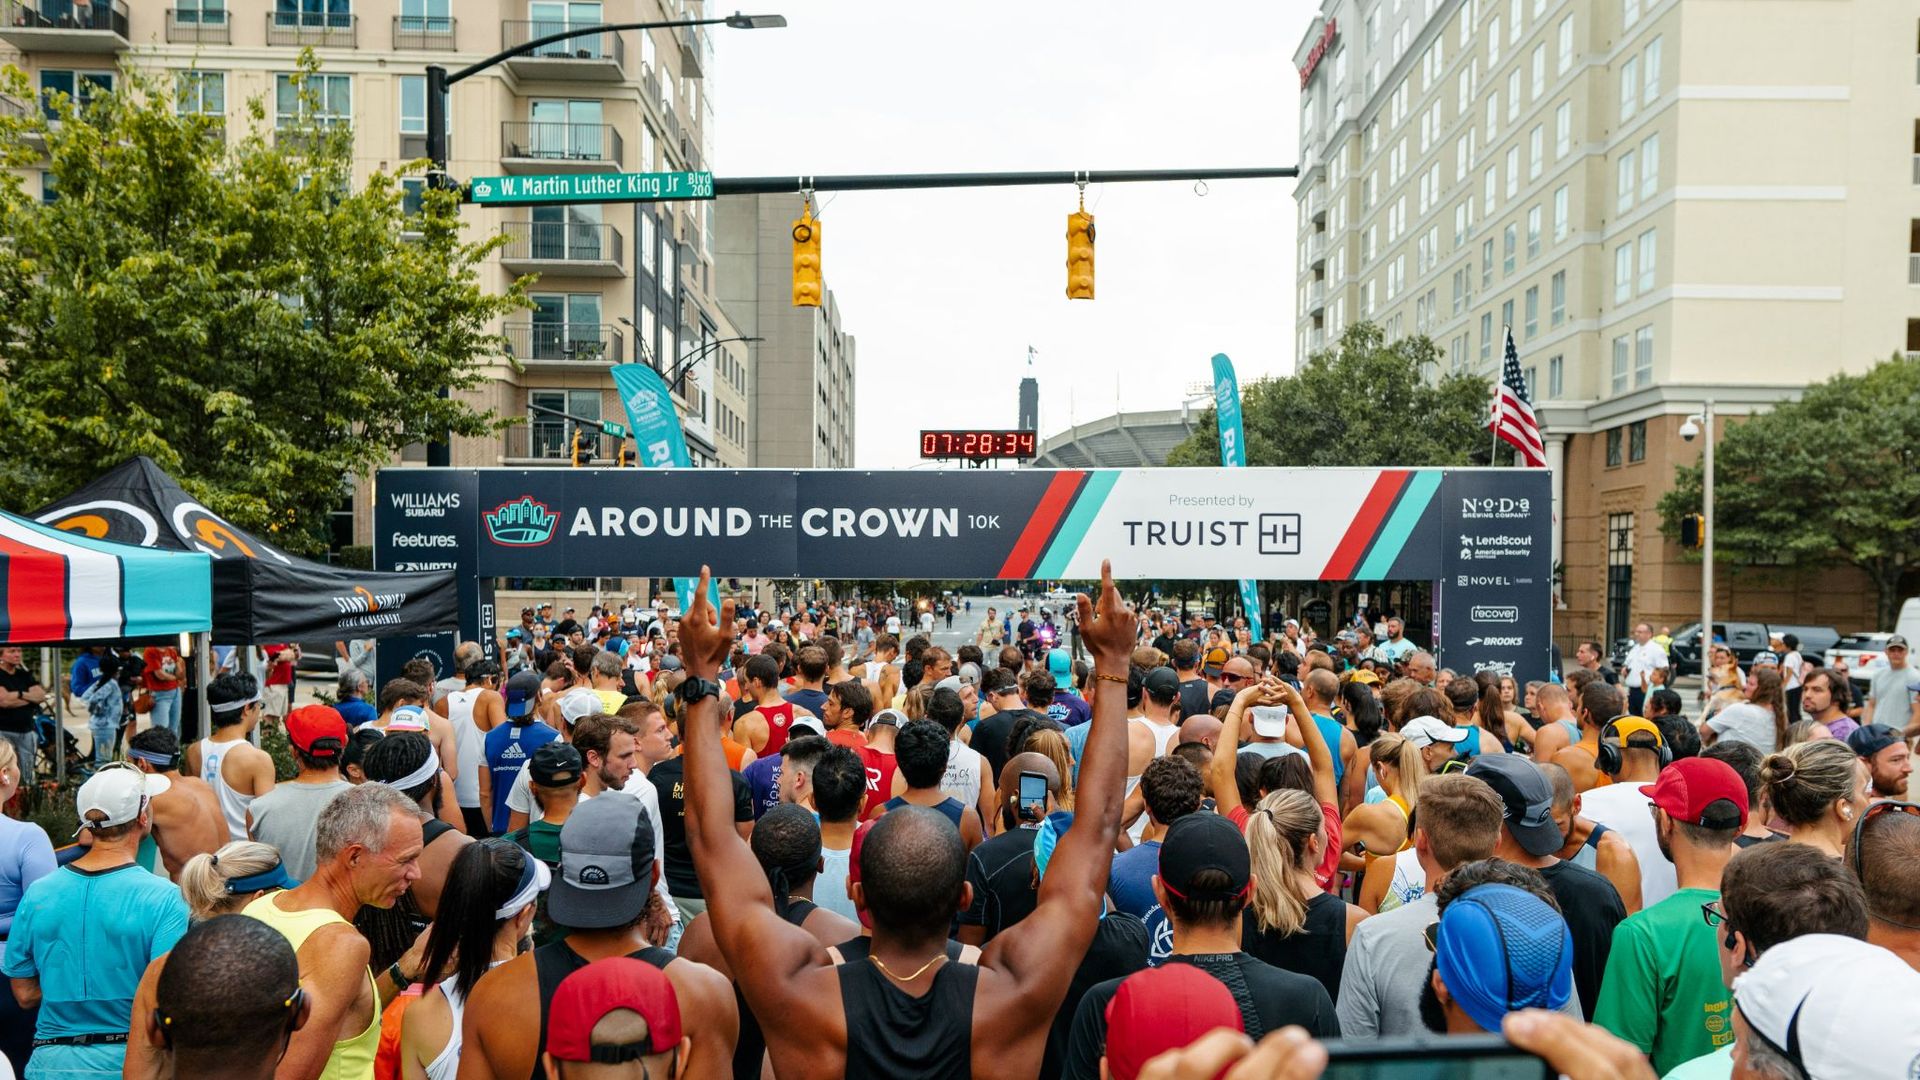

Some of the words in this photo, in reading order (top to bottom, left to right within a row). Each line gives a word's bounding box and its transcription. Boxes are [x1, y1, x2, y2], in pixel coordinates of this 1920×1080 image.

[500, 178, 516, 196] W.
[522, 176, 568, 195] Martin
[575, 175, 622, 194] Luther
[628, 174, 660, 197] King
[665, 174, 679, 193] Jr
[687, 172, 711, 185] Blvd
[691, 185, 711, 197] 200
[923, 433, 1033, 454] 07:28:34
[390, 493, 461, 508] WILLIAMS
[1169, 494, 1235, 506] Presented
[1238, 494, 1255, 508] by
[405, 508, 445, 517] SUBARU
[568, 506, 752, 537] AROUND
[758, 514, 793, 529] THE
[801, 507, 959, 538] CROWN
[967, 514, 1000, 529] 10K
[1123, 520, 1249, 546] TRUIST
[1476, 535, 1532, 546] LendScout
[1474, 548, 1504, 556] American
[1504, 548, 1531, 557] Security
[1470, 576, 1511, 586] NOVEL
[359, 613, 402, 626] MANAGEMENT
[1474, 609, 1515, 618] recover
[1483, 637, 1524, 646] BROOKS
[1193, 954, 1215, 962] NIKE
[1215, 954, 1234, 962] PRO
